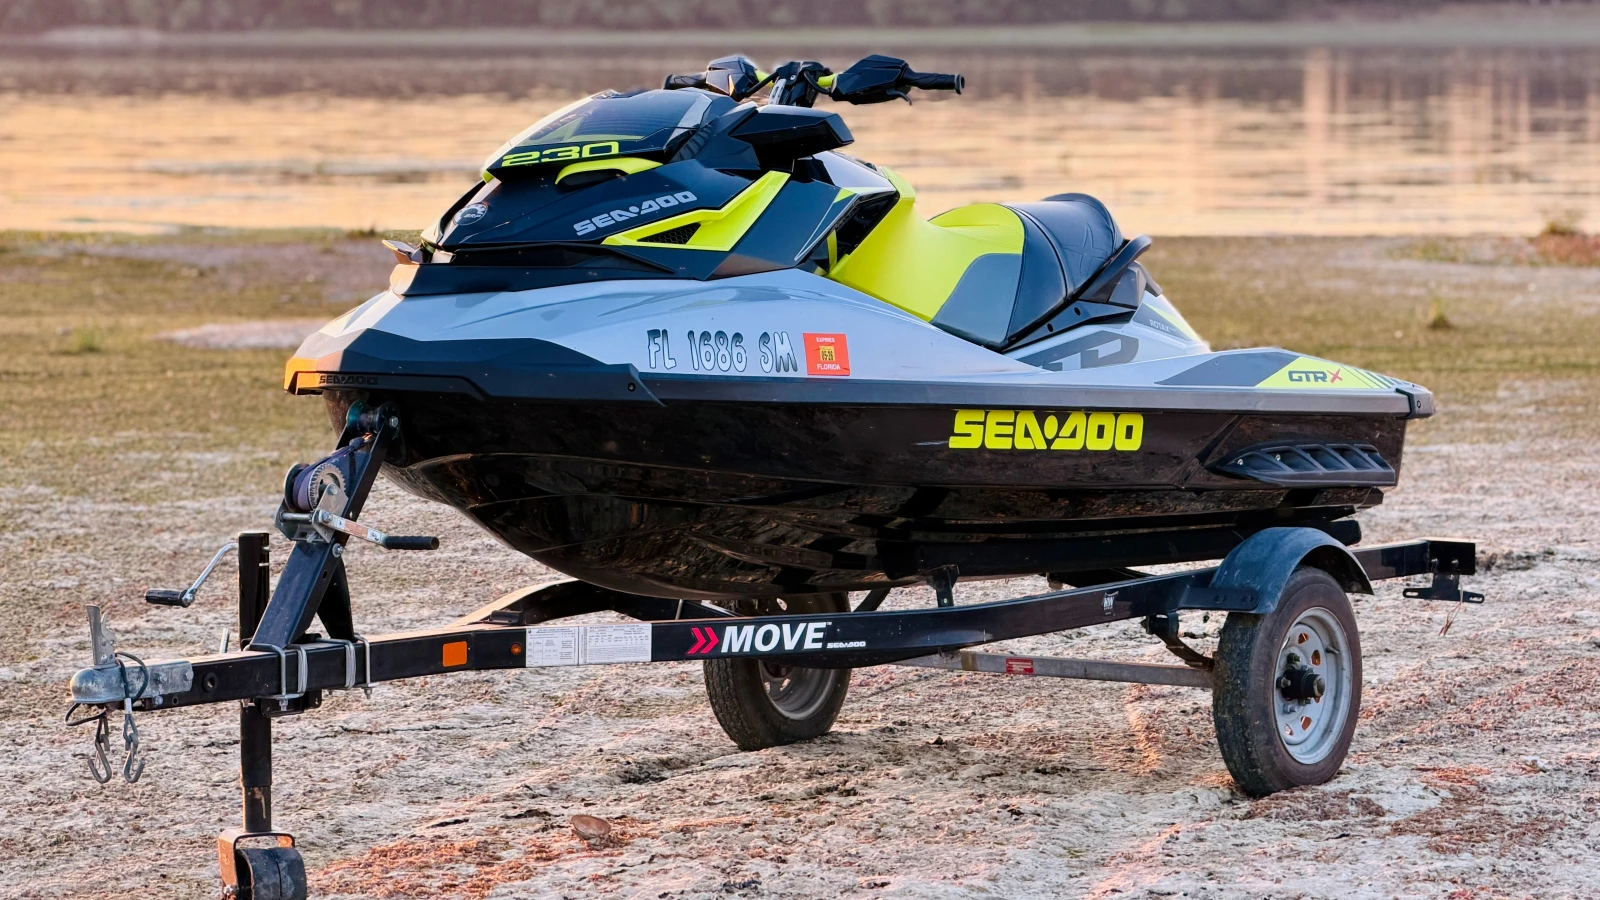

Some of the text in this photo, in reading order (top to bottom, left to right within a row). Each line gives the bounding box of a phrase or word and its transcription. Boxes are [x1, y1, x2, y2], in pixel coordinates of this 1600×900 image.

[501, 141, 620, 167] 230
[647, 328, 799, 373] FL 1686 SM
[816, 363, 841, 371] FLORIDA
